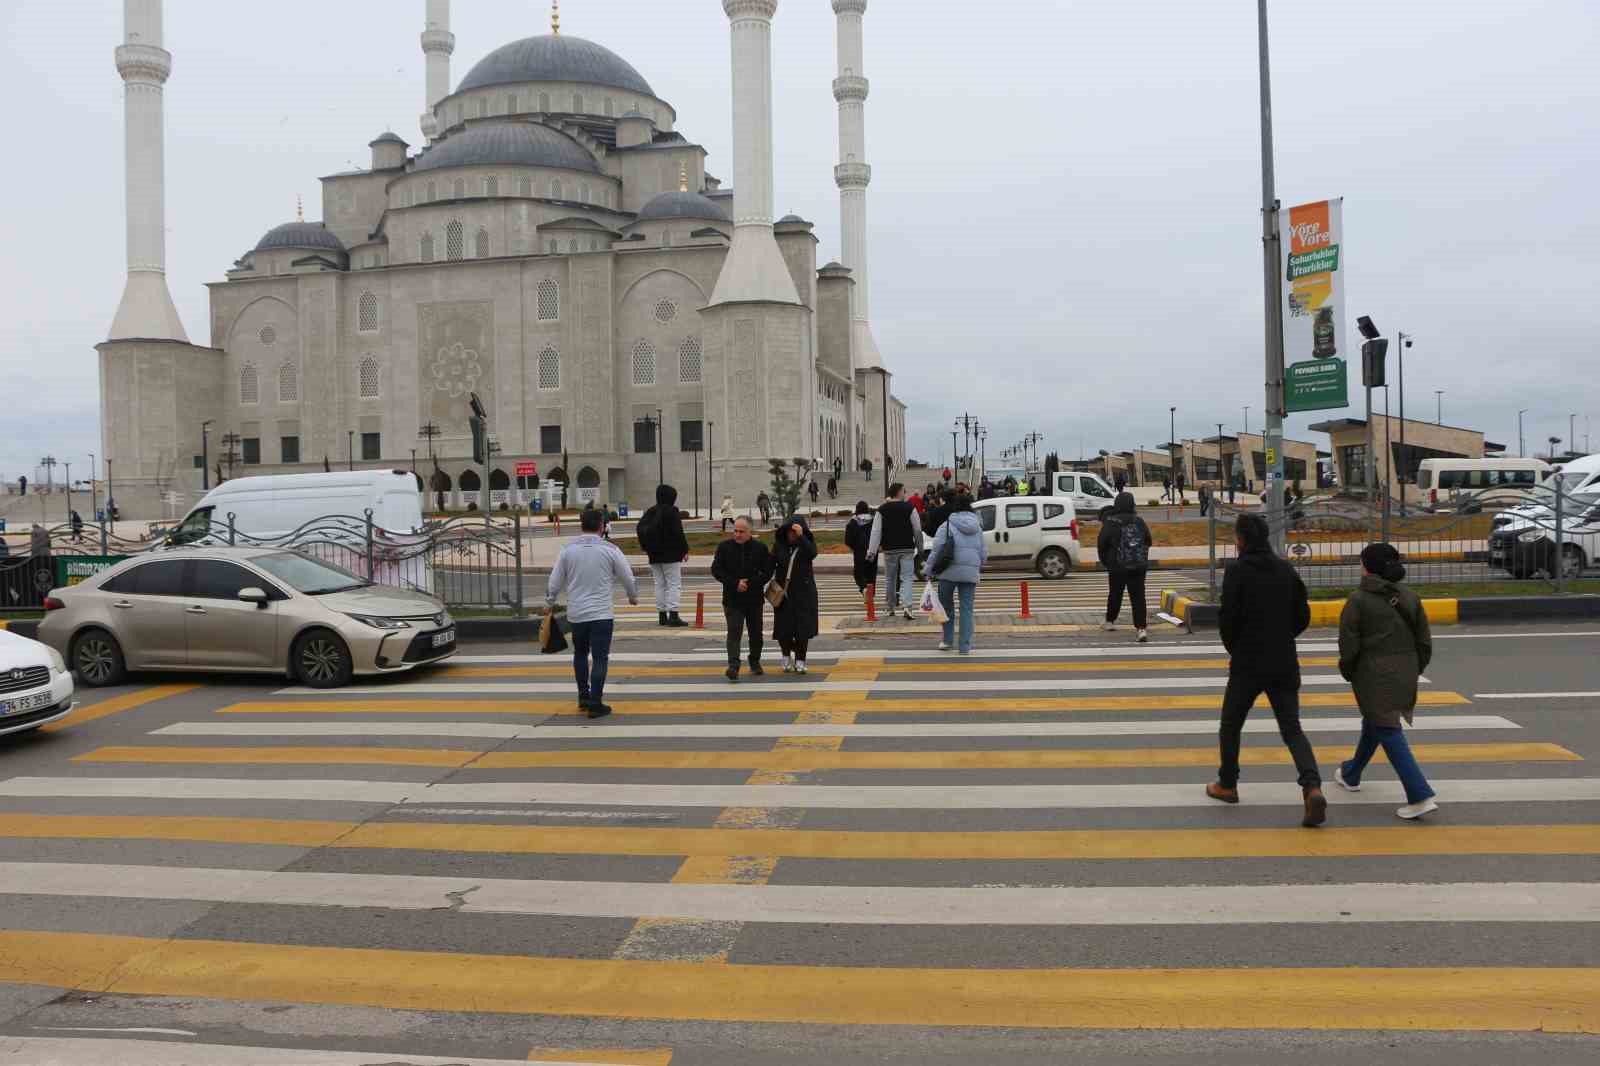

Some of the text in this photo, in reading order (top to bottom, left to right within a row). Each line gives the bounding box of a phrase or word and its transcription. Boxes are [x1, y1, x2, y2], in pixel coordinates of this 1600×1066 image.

[1289, 223, 1320, 238] Yöre
[1299, 231, 1329, 247] Yöre
[20, 697, 30, 709] FS
